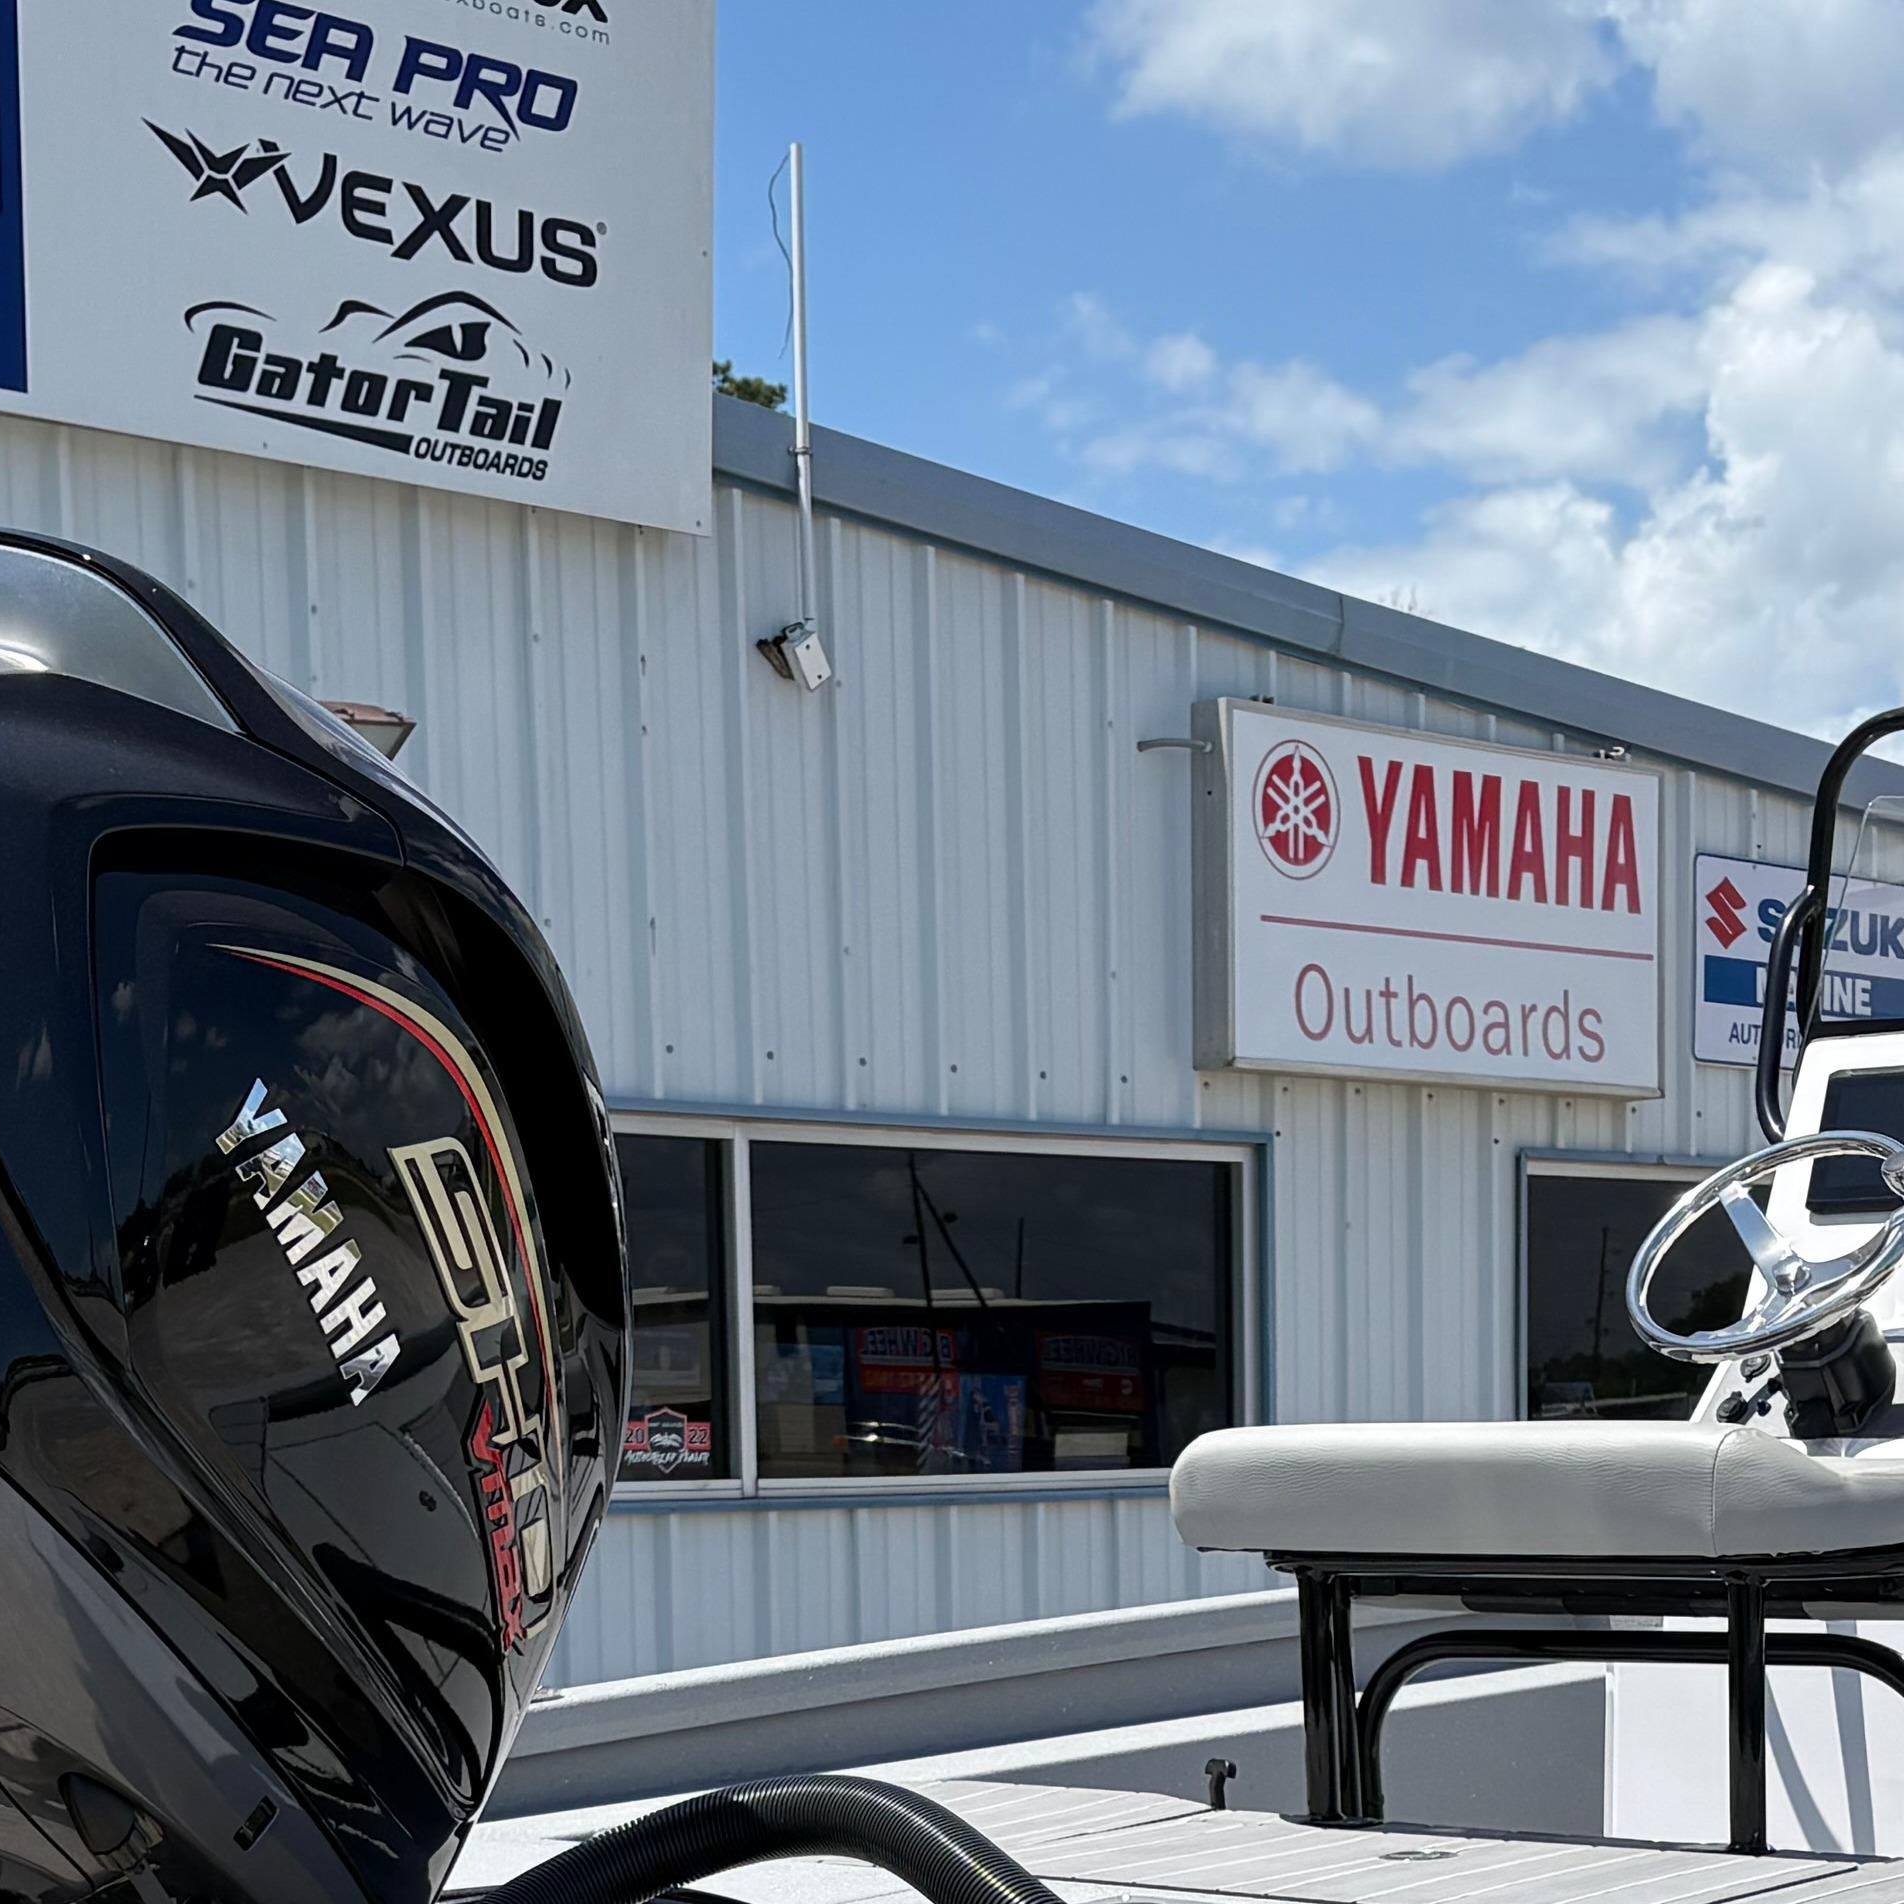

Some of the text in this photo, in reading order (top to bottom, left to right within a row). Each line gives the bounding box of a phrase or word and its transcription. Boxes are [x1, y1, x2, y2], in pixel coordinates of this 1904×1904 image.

[171, 45, 510, 153] the next wave
[172, 0, 578, 142] SEA PRO
[258, 138, 598, 288] VEXUS
[197, 323, 563, 451] GatorTail
[413, 436, 549, 482] OUTBOARDS
[1357, 755, 1642, 915] YAMAHA
[1294, 963, 1606, 1064] Outboards
[215, 1077, 401, 1407] YAMAHA
